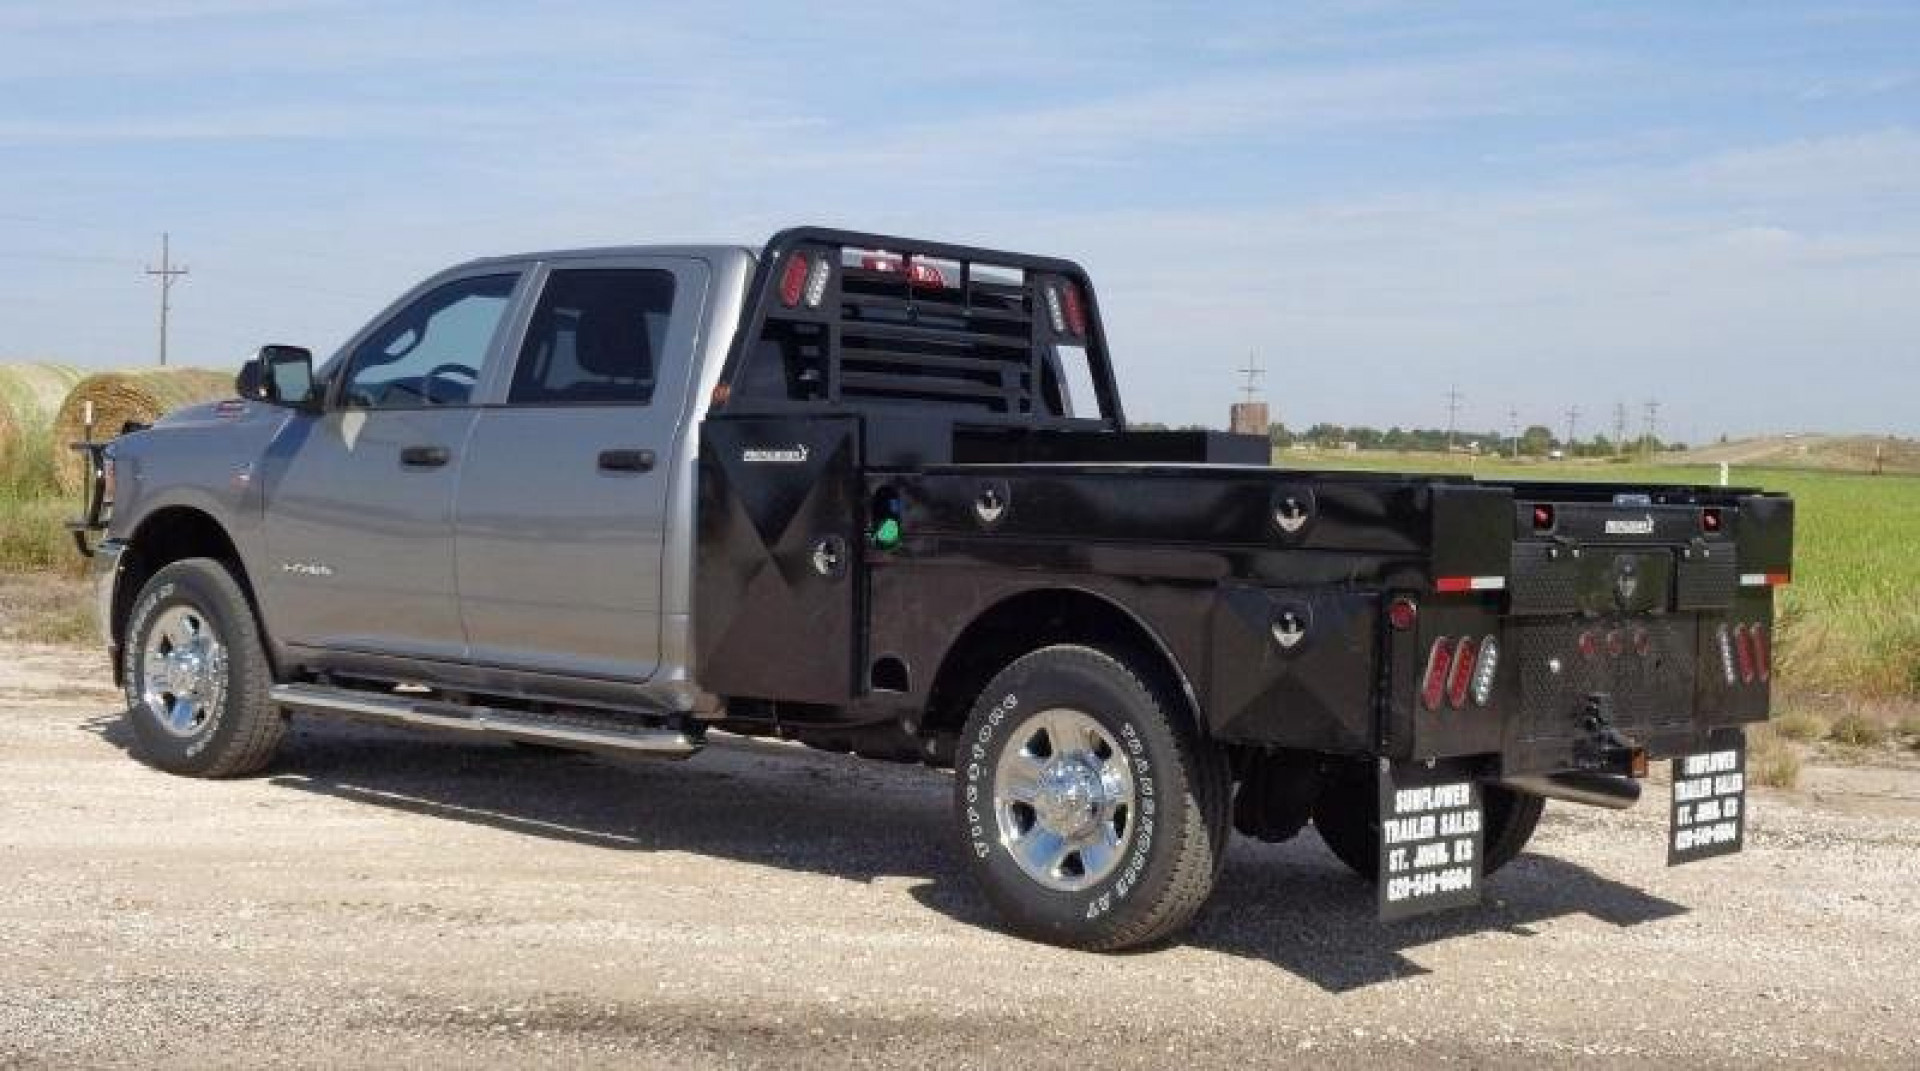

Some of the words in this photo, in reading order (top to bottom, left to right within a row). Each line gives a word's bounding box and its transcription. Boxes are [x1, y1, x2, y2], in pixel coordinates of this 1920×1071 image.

[1395, 783, 1469, 814] SUNFLOWER
[1384, 815, 1436, 844] TRAILER
[1440, 810, 1480, 836] SALES
[1454, 838, 1472, 863] KS
